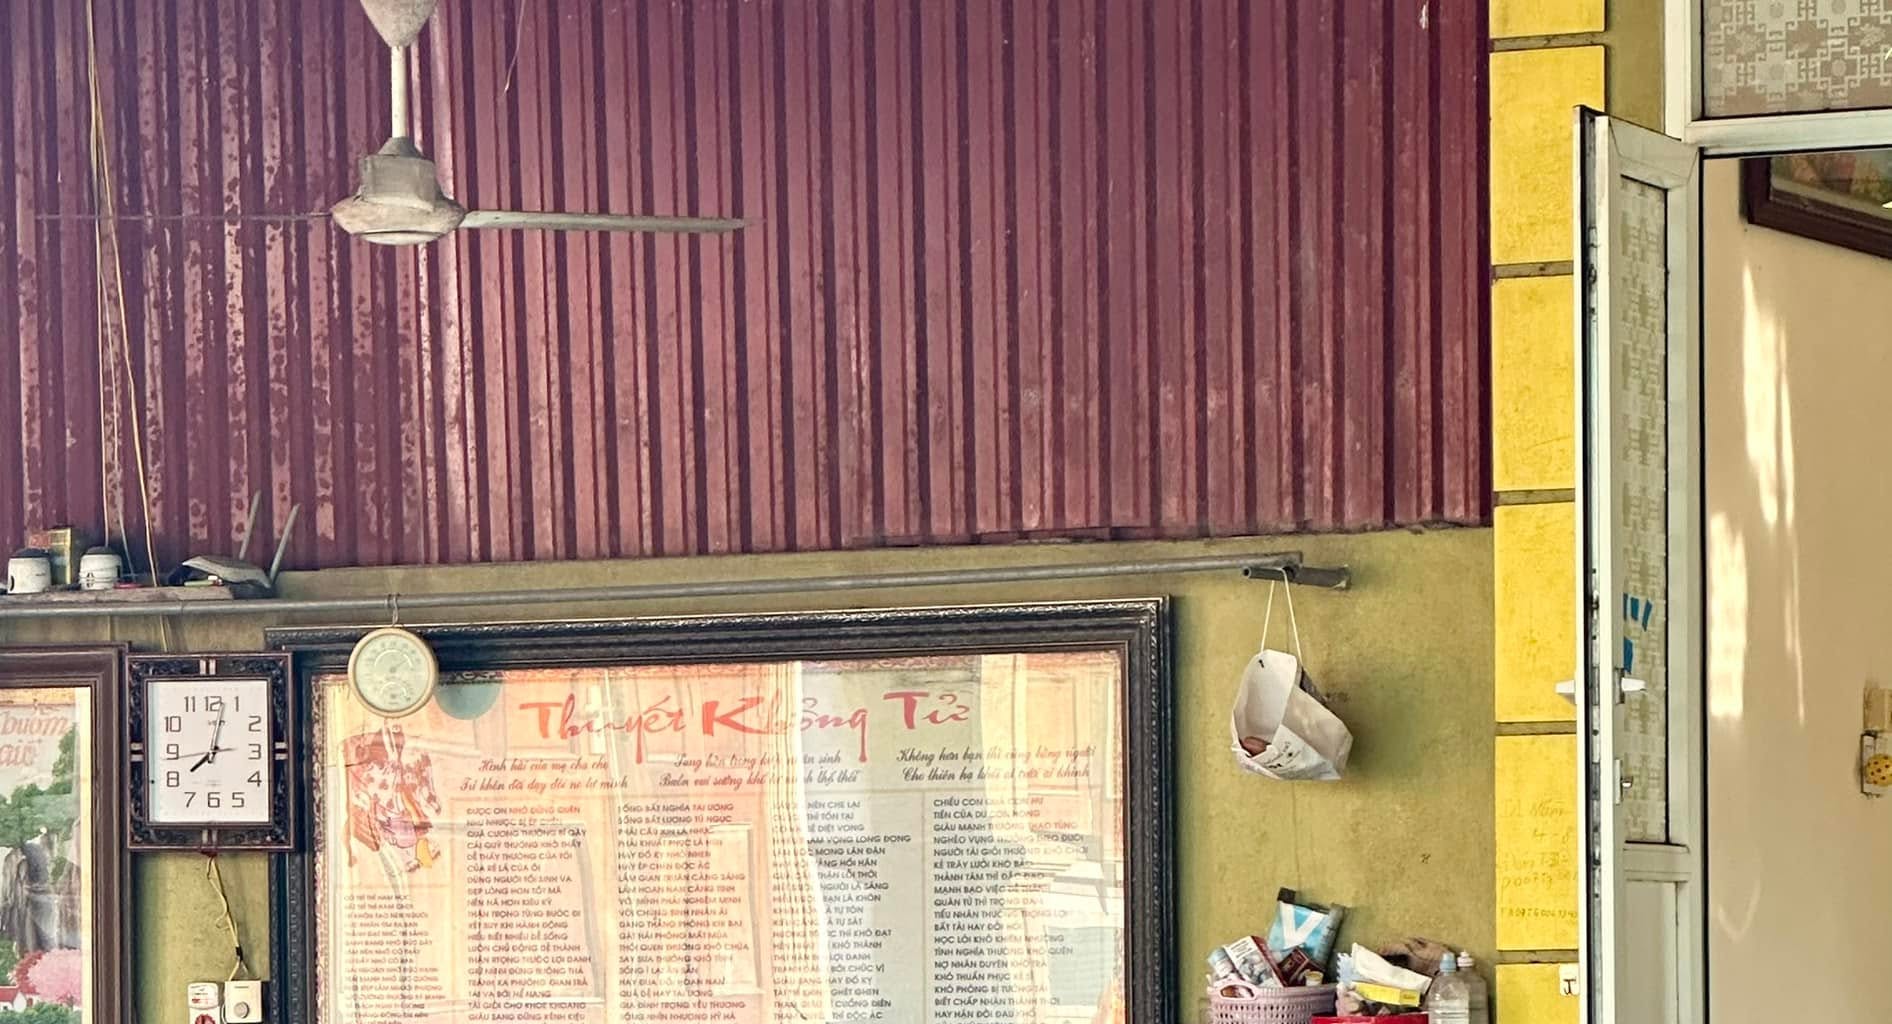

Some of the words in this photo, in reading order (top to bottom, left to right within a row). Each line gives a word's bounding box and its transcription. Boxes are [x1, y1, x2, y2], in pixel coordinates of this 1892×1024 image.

[184, 696, 195, 712] 11
[205, 696, 223, 711] 12
[234, 696, 239, 711] 1
[165, 716, 181, 732] 10
[249, 716, 261, 731] 2
[167, 744, 179, 760] 9
[248, 744, 261, 760] 3
[167, 771, 179, 787] 8
[248, 771, 262, 786] 4
[184, 792, 196, 808] 7
[208, 792, 220, 808] 6
[232, 792, 244, 808] 5
